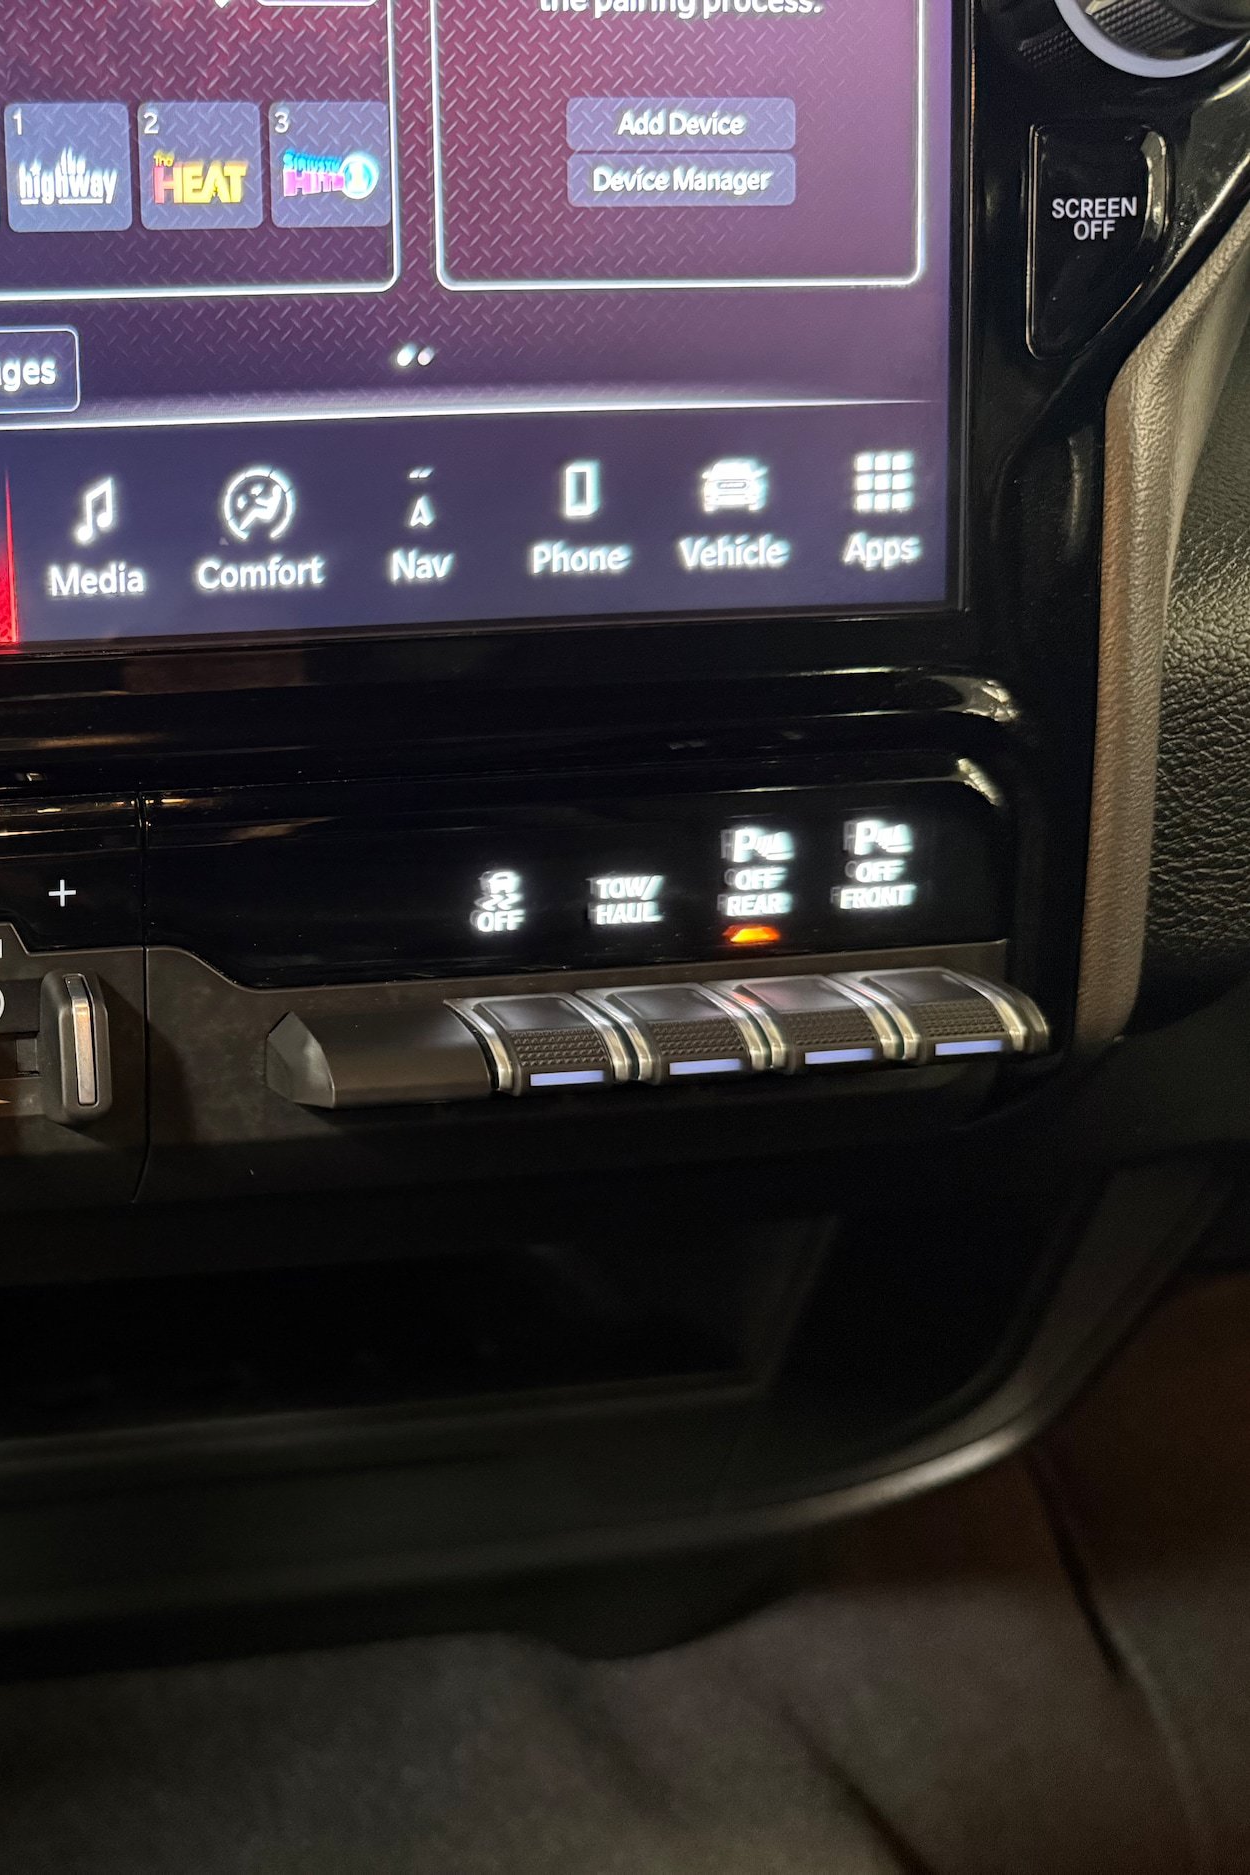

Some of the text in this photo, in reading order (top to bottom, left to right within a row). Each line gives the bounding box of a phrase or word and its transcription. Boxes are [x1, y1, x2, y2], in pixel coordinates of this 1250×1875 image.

[13, 108, 22, 135] 1
[143, 110, 158, 134] 2
[274, 110, 290, 133] 3
[617, 110, 747, 136] Add Device
[18, 160, 118, 205] highway
[153, 158, 248, 204] HEAT
[593, 166, 772, 196] Device Manager
[1051, 196, 1138, 219] SCREEN
[1073, 220, 1116, 240] OFF
[531, 541, 629, 575] Phone
[681, 533, 788, 571] Vehicle
[844, 532, 921, 570] Apps
[196, 555, 325, 590] Comfort
[391, 549, 452, 583] Nav
[50, 562, 145, 598] Media
[735, 867, 787, 890] OFF
[855, 859, 905, 882] OFF
[595, 874, 664, 901] TOW/
[839, 884, 917, 909] FRONT
[595, 901, 664, 925] HAUL
[725, 892, 792, 916] REAR
[476, 909, 524, 933] OFF
